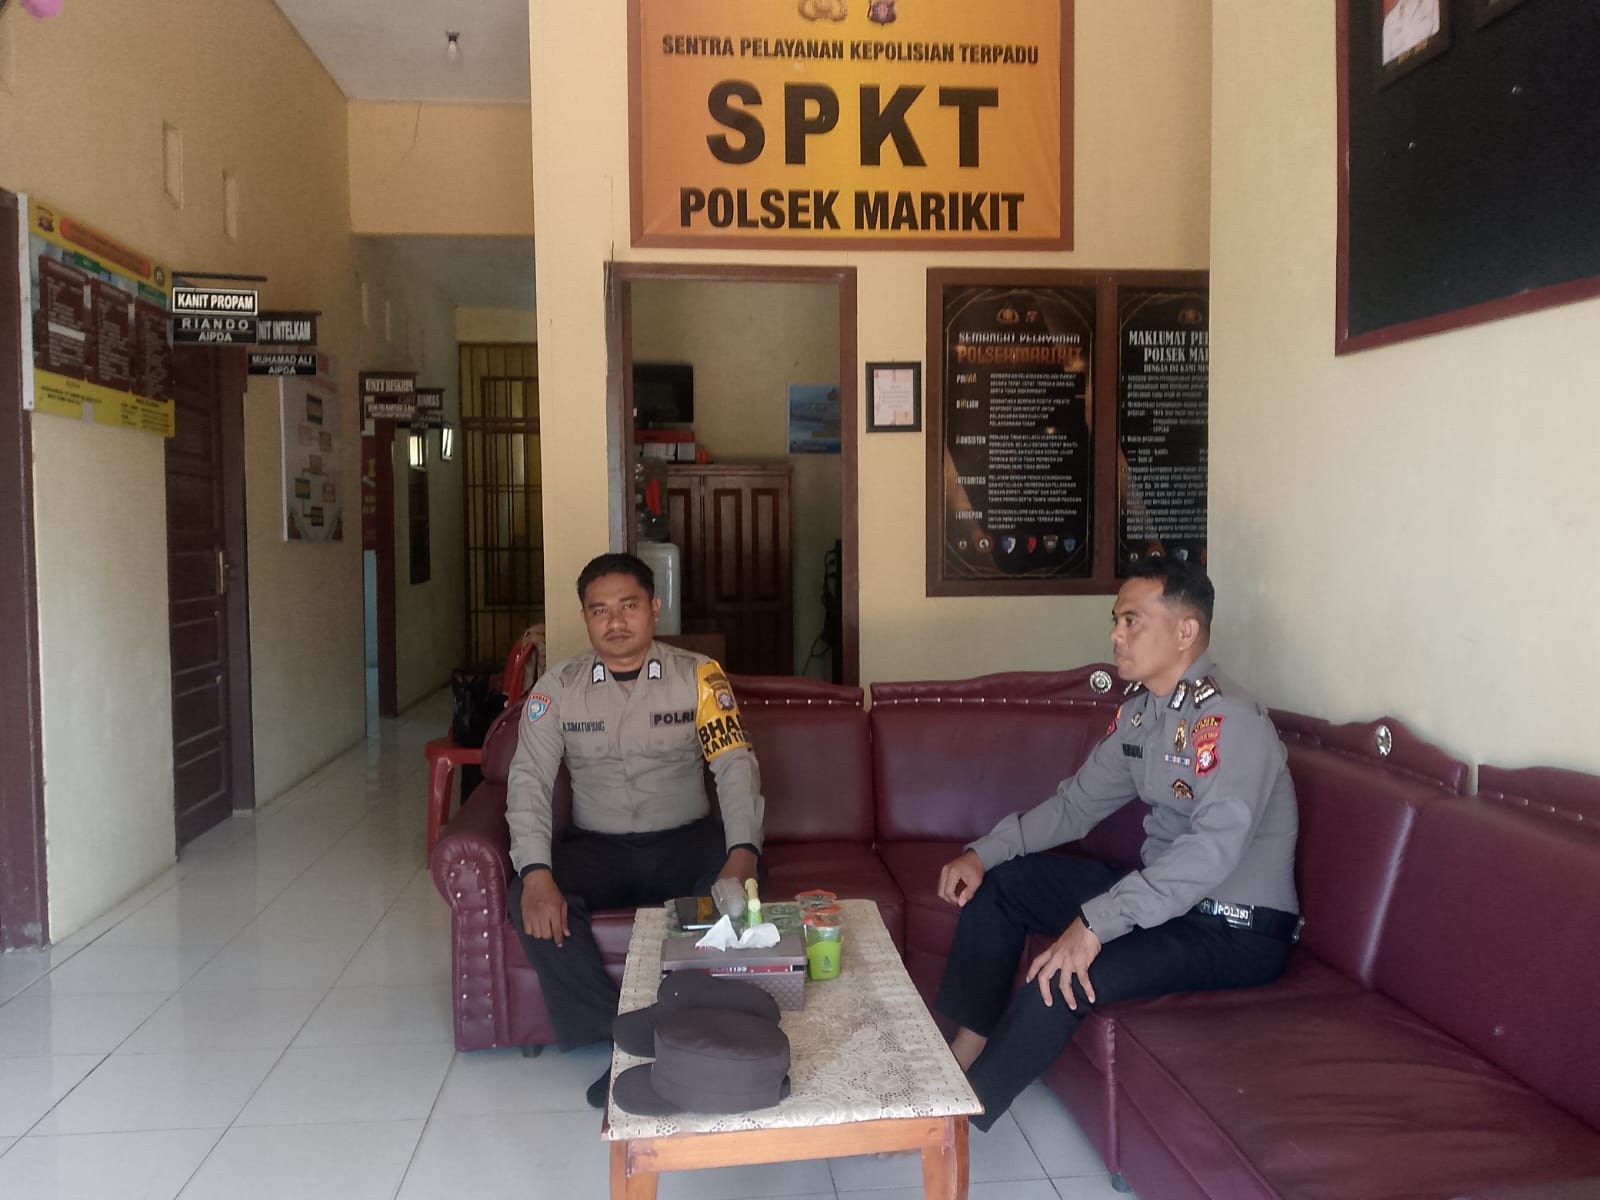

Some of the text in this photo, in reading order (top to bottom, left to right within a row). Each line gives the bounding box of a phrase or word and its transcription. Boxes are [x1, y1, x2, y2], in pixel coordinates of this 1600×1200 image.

[662, 35, 1039, 65] SENTRA PELAYANAN KEPOLISIAN TERPADU
[706, 79, 999, 168] SPKT
[680, 187, 1025, 232] POLSEK MARIKIT
[177, 293, 253, 310] KANIT PROPAM
[182, 317, 249, 330] RIANDO
[273, 320, 311, 341] INTELKAM
[198, 331, 233, 342] AIPDA
[1129, 330, 1187, 346] MAKLUMAT
[252, 355, 312, 365] MUHAMAD ALI
[1144, 347, 1185, 362] POLSEK
[268, 366, 296, 375] AIPDA
[653, 710, 694, 725] POLRI
